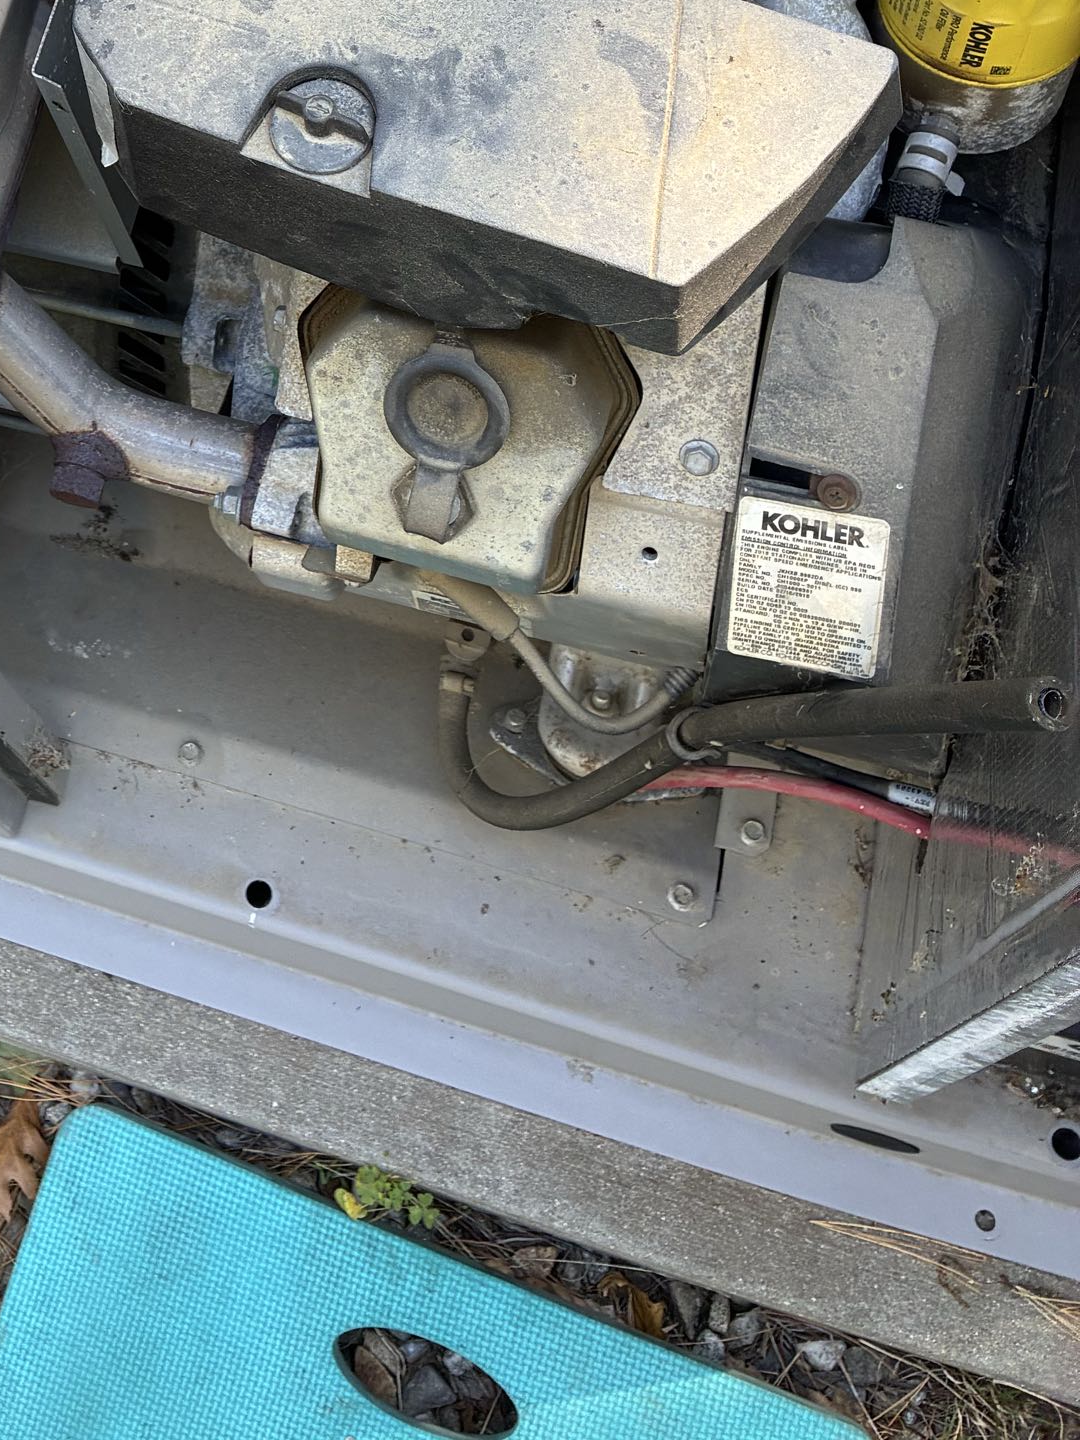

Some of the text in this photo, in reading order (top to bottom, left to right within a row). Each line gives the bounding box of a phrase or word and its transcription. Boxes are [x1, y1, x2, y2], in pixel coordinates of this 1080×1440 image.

[935, 8, 949, 32] Oil Filter
[940, 14, 962, 61] PRO Performance
[960, 21, 995, 68] KOHLER
[761, 510, 867, 548] KOHLER
[741, 535, 847, 558] EMISSION CONTROL INFORMATION
[742, 529, 848, 552] SUPPLEMENTAL EMISSIONS LABEL
[757, 544, 779, 552] ENGINE
[739, 562, 762, 570] FAMILY
[740, 552, 771, 561] CONSTANT
[796, 562, 833, 573] EMERGENCY
[836, 569, 882, 581] APPLICATIONS
[771, 552, 809, 562] STATIONARY
[747, 594, 785, 605] CERTIFICATE
[763, 627, 789, 635] QUALITY
[825, 638, 861, 649] CONVERTED
[783, 625, 815, 635] CERTIFIED
[827, 633, 854, 643] OPERATE
[794, 642, 819, 651] MANUAL
[815, 651, 860, 663] ADJUSTMENTS
